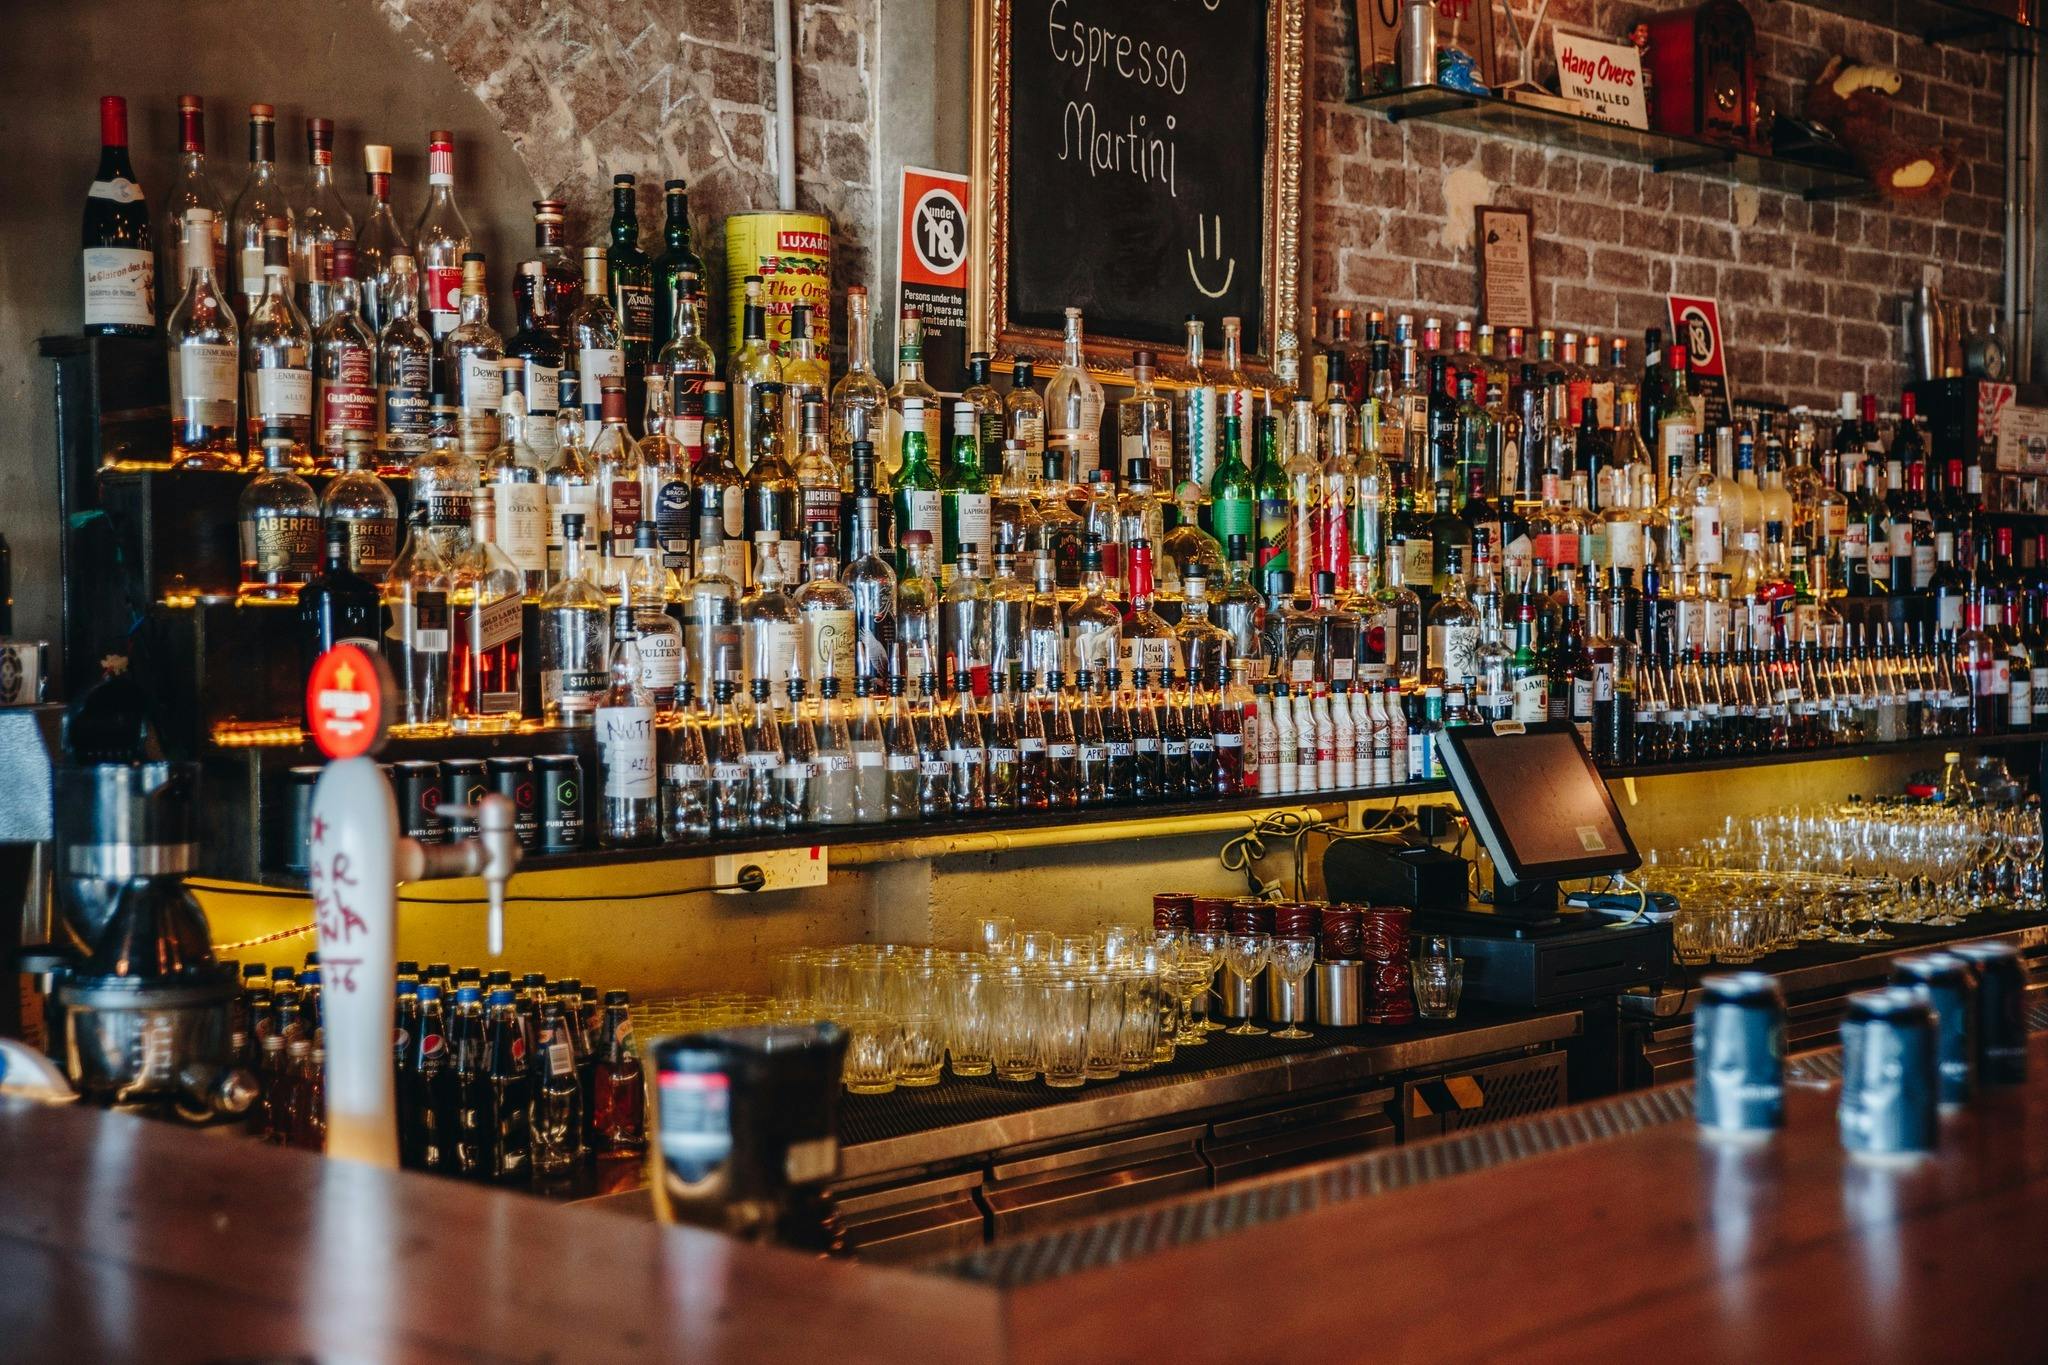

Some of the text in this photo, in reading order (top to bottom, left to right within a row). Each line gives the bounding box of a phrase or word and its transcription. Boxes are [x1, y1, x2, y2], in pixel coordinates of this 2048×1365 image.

[1049, 0, 1187, 94] Espresso
[1561, 47, 1636, 87] Hang Overs
[1571, 85, 1630, 106] INSTALLED
[1058, 101, 1177, 197] Martini
[929, 205, 955, 220] under
[924, 219, 955, 260] 18
[767, 280, 797, 296] The
[904, 288, 962, 305] Persons under the
[925, 304, 933, 314] 18
[933, 305, 952, 317] years
[952, 307, 963, 316] are
[948, 316, 956, 327] in
[955, 317, 967, 328] this
[928, 326, 942, 337] law.
[508, 505, 539, 513] OBAN
[295, 543, 307, 554] 12
[361, 545, 376, 557] 21
[498, 606, 521, 619] LABEL
[656, 638, 676, 647] OLD
[564, 788, 572, 798] 6
[546, 819, 564, 828] PURE
